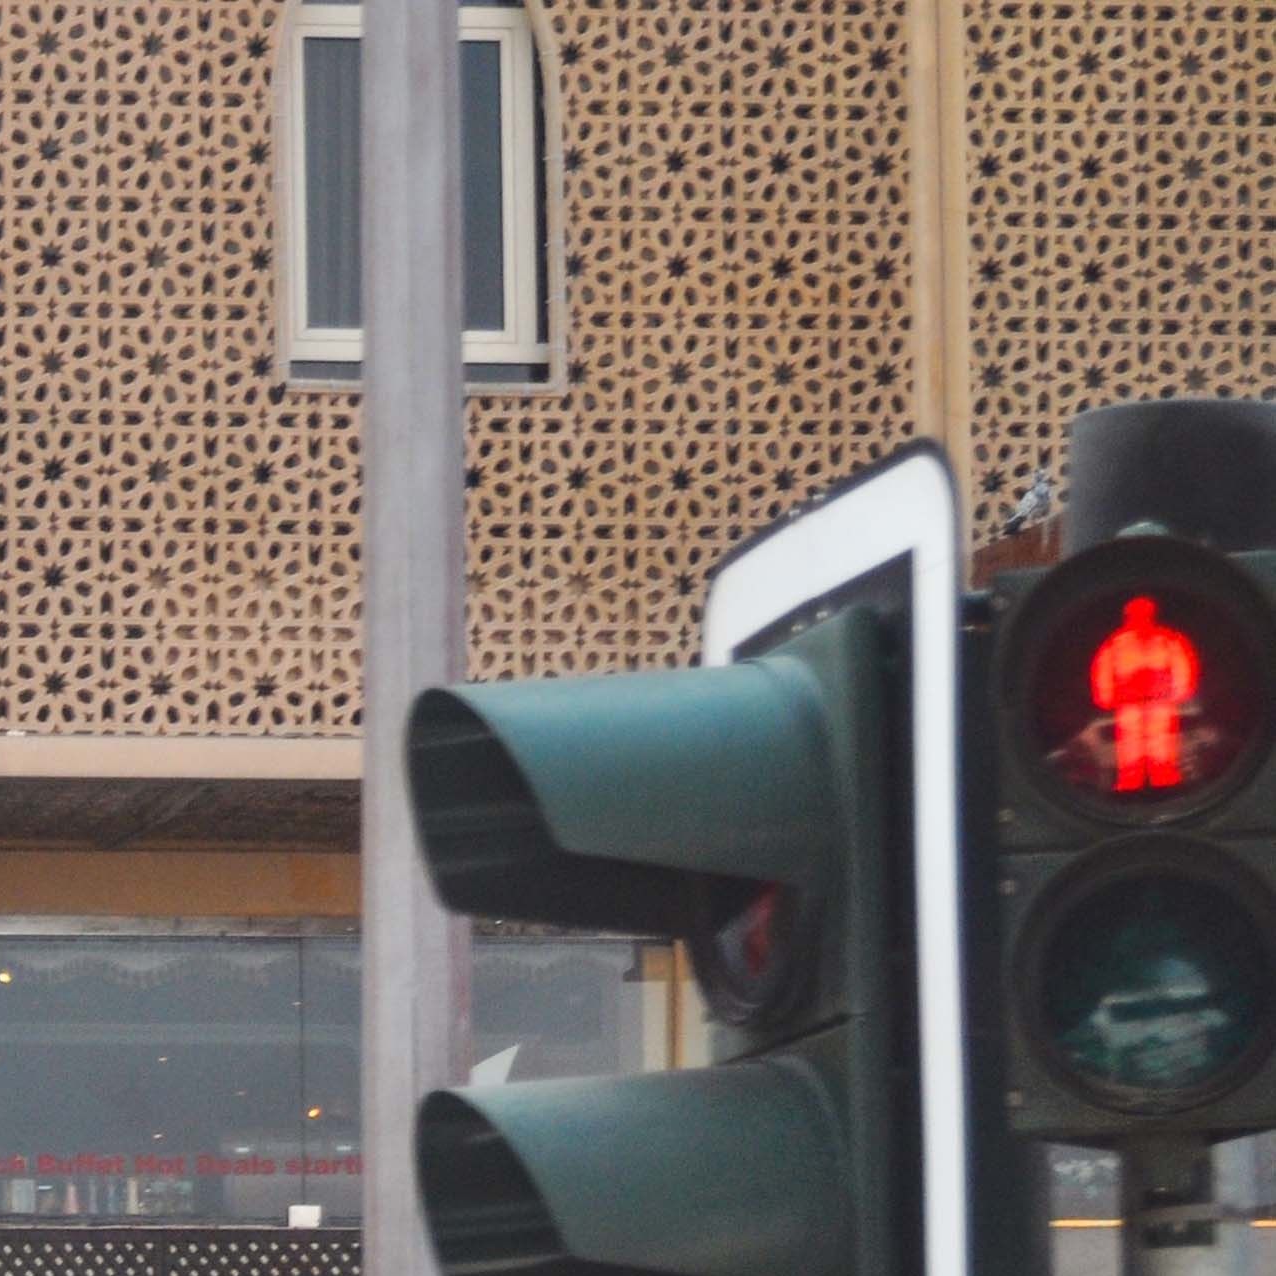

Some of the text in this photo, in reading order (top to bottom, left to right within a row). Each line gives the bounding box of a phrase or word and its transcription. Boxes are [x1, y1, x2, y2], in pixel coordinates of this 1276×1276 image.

[37, 1153, 125, 1176] Buffet
[134, 1154, 186, 1177] Hot
[197, 1154, 275, 1175] Deals
[285, 1155, 362, 1176] starti
